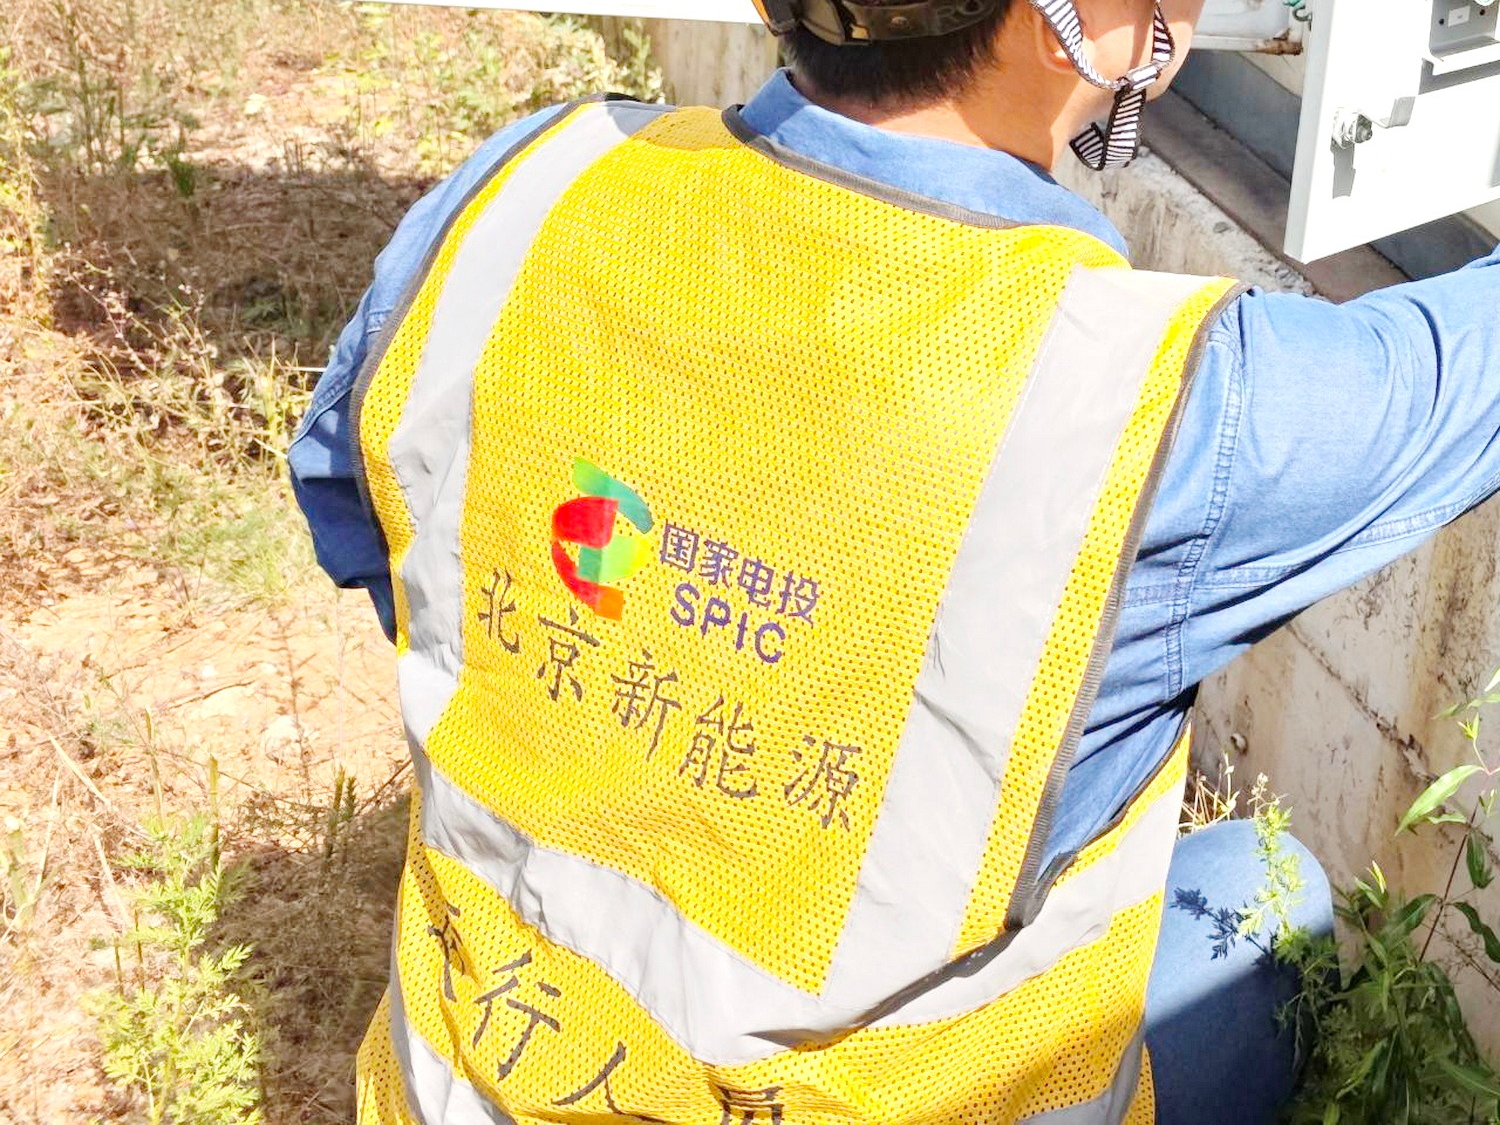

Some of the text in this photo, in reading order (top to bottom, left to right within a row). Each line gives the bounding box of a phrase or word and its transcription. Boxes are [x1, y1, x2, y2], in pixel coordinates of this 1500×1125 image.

[659, 520, 820, 629] 国家电投
[670, 581, 787, 665] SPIC
[477, 565, 863, 831] 北京新能源
